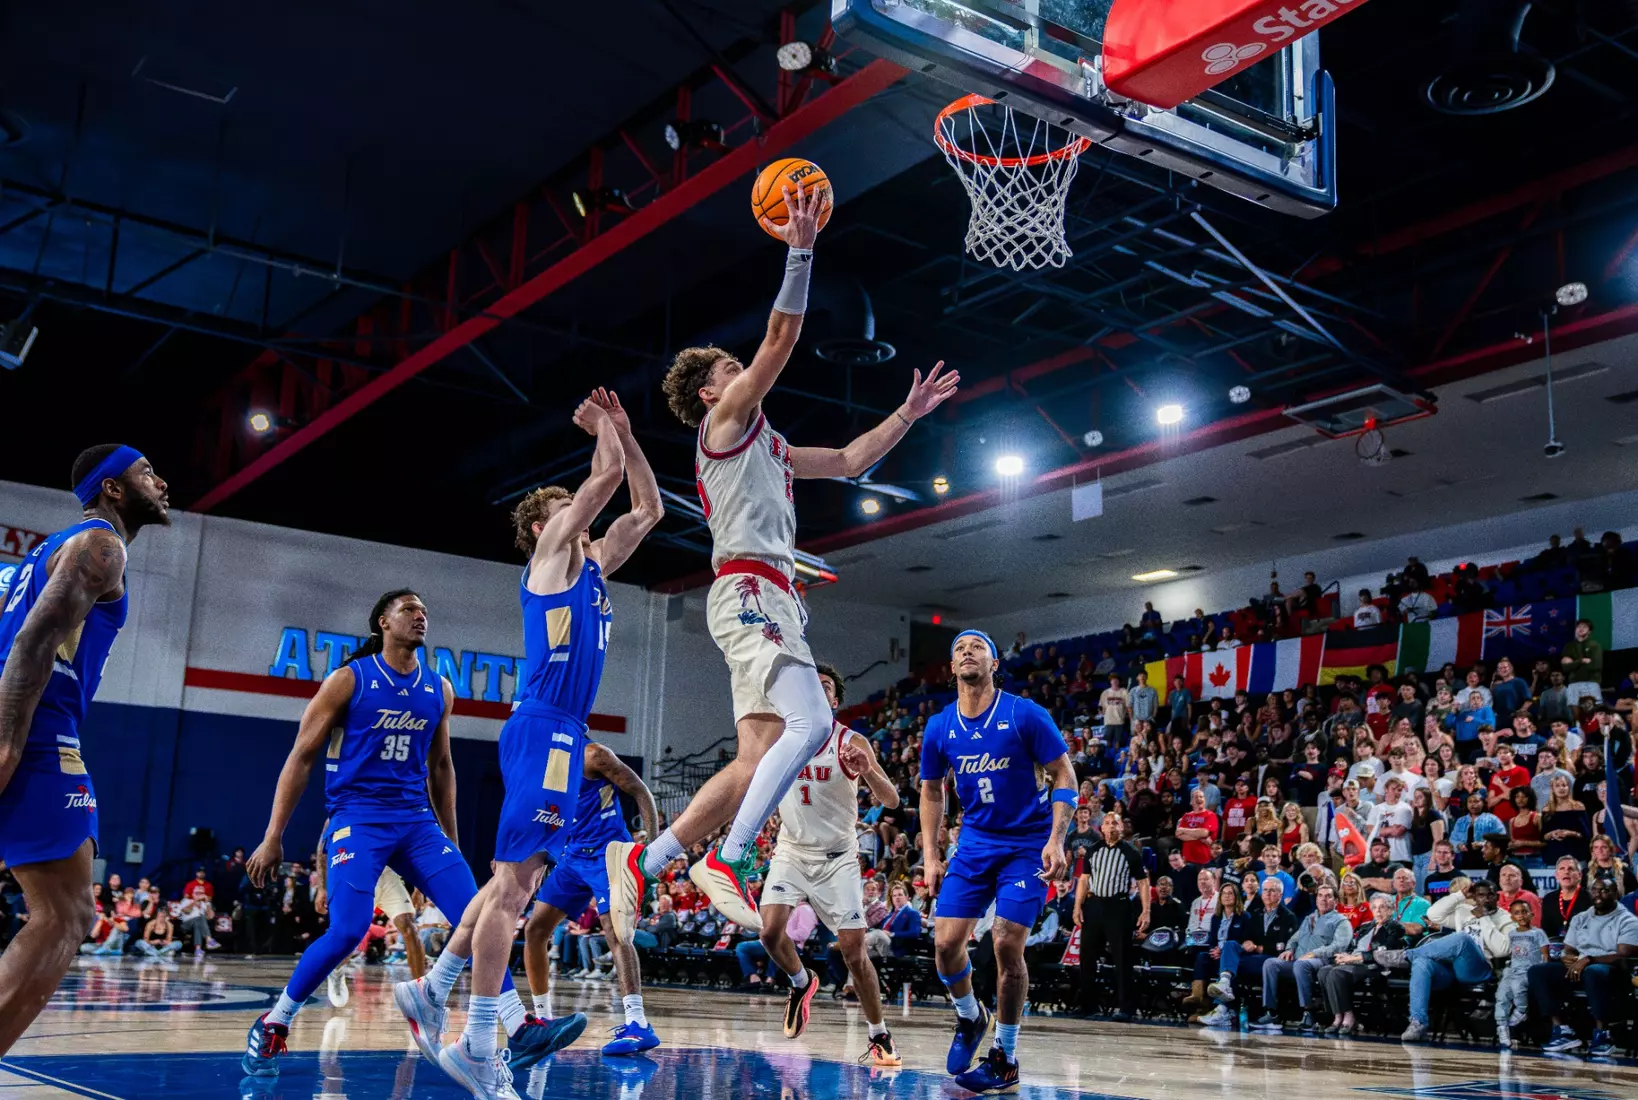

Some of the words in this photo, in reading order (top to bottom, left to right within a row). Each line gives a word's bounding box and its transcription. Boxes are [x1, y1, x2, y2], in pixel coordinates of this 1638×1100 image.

[1253, 0, 1350, 42] Sta
[269, 626, 530, 702] ATNTI
[371, 709, 428, 730] Tulsa
[380, 734, 411, 761] 35
[797, 764, 832, 783] AU
[957, 752, 1010, 774] Tulsa
[799, 784, 812, 806] 1
[977, 777, 995, 803] 2
[532, 808, 566, 827] Tulsa
